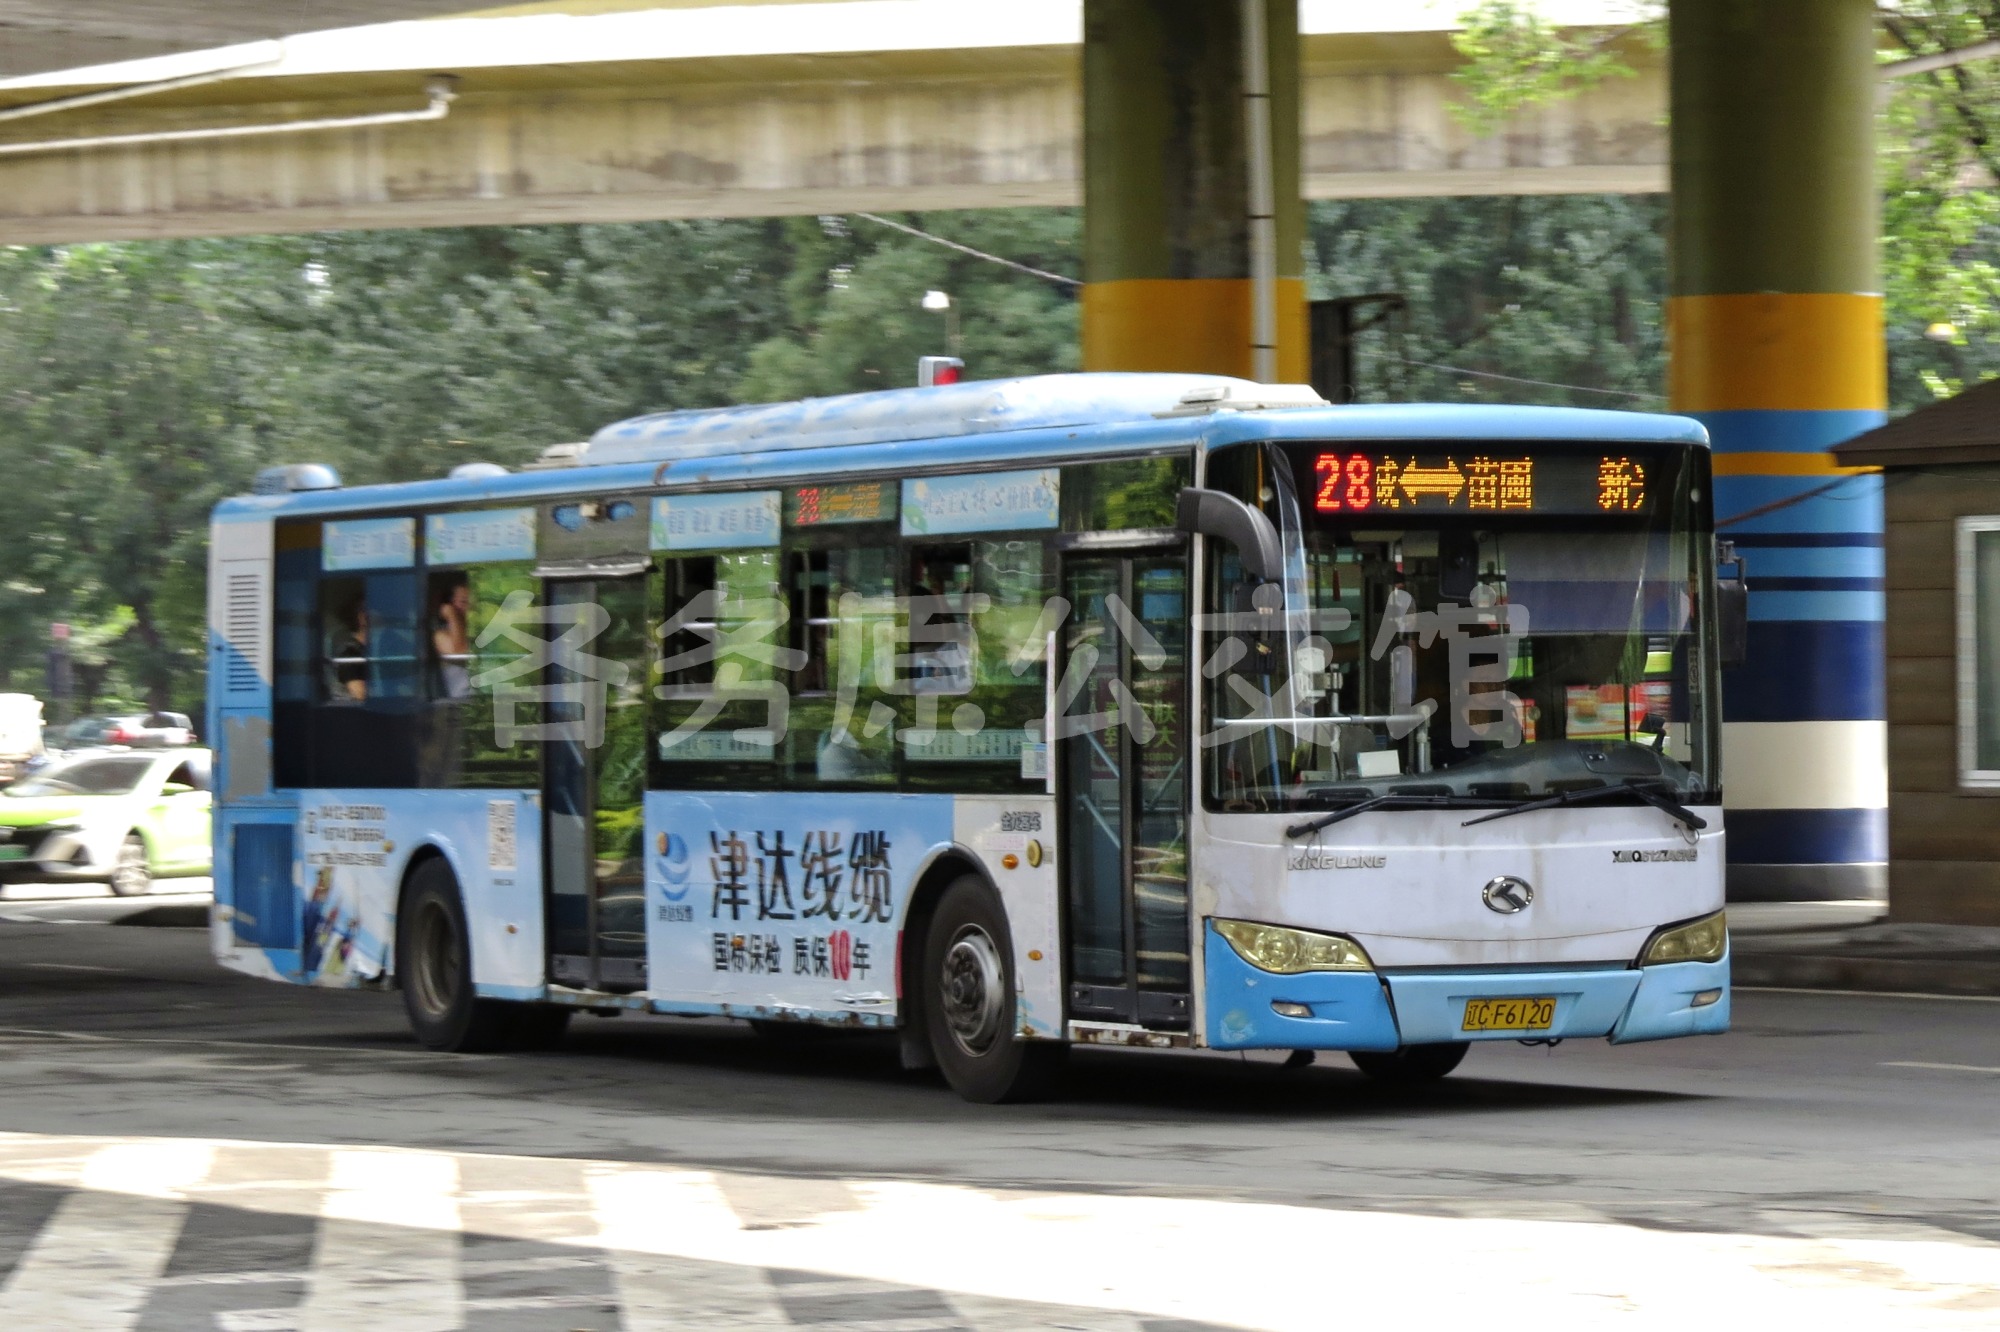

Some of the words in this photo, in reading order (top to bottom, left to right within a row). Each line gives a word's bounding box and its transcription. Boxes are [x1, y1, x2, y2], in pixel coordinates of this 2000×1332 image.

[1316, 455, 1371, 508] 28
[1001, 811, 1042, 832] 金龙客车
[708, 829, 894, 924] 津达线缆
[793, 929, 872, 981] 质保10年
